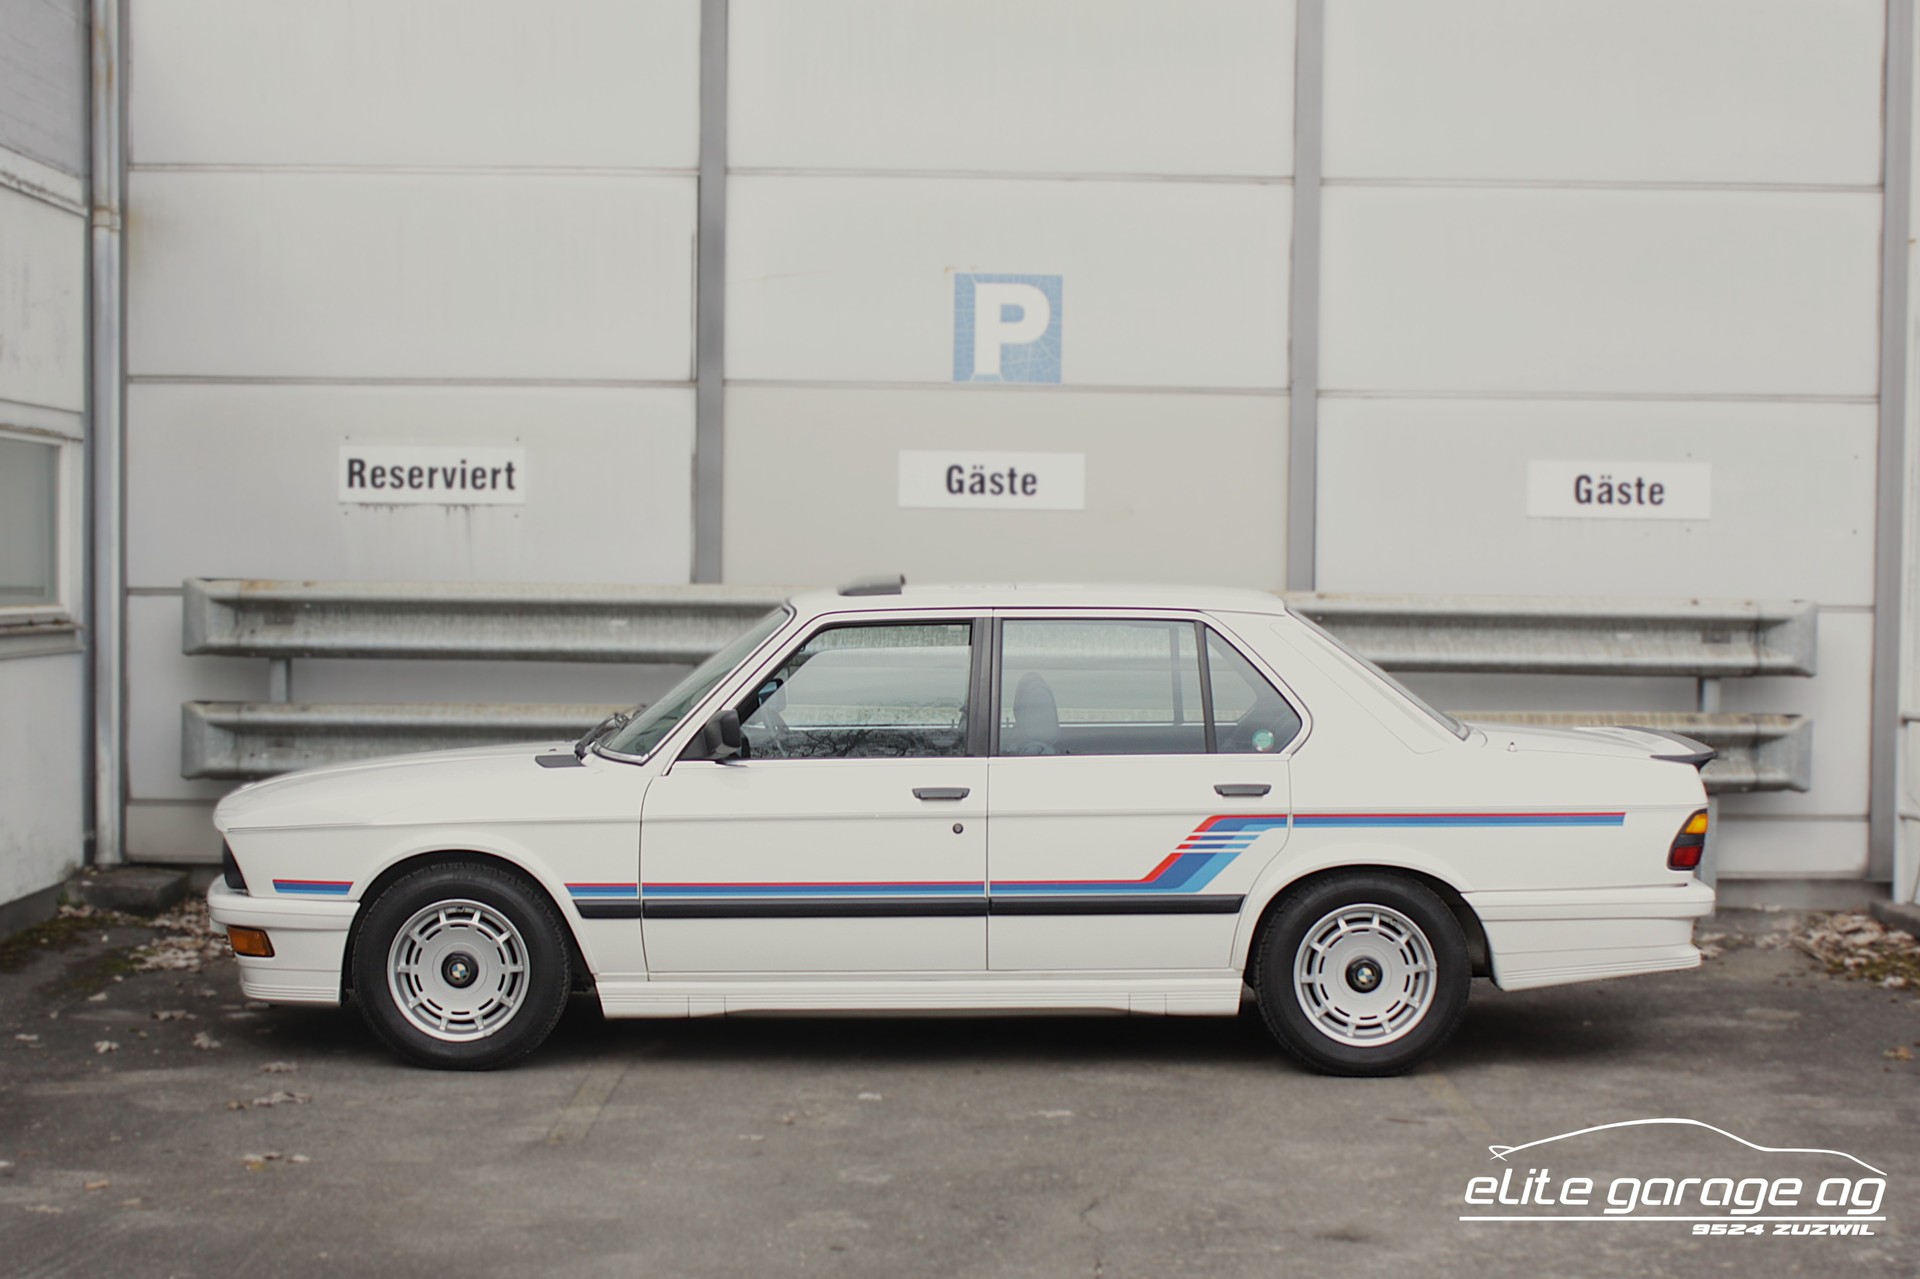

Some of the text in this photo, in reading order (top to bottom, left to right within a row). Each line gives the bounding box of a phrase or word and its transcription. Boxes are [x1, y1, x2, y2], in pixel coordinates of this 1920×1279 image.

[973, 283, 1051, 374] P
[348, 459, 515, 490] Reserviert
[947, 465, 1036, 495] Gäste
[1575, 475, 1663, 505] Gäste
